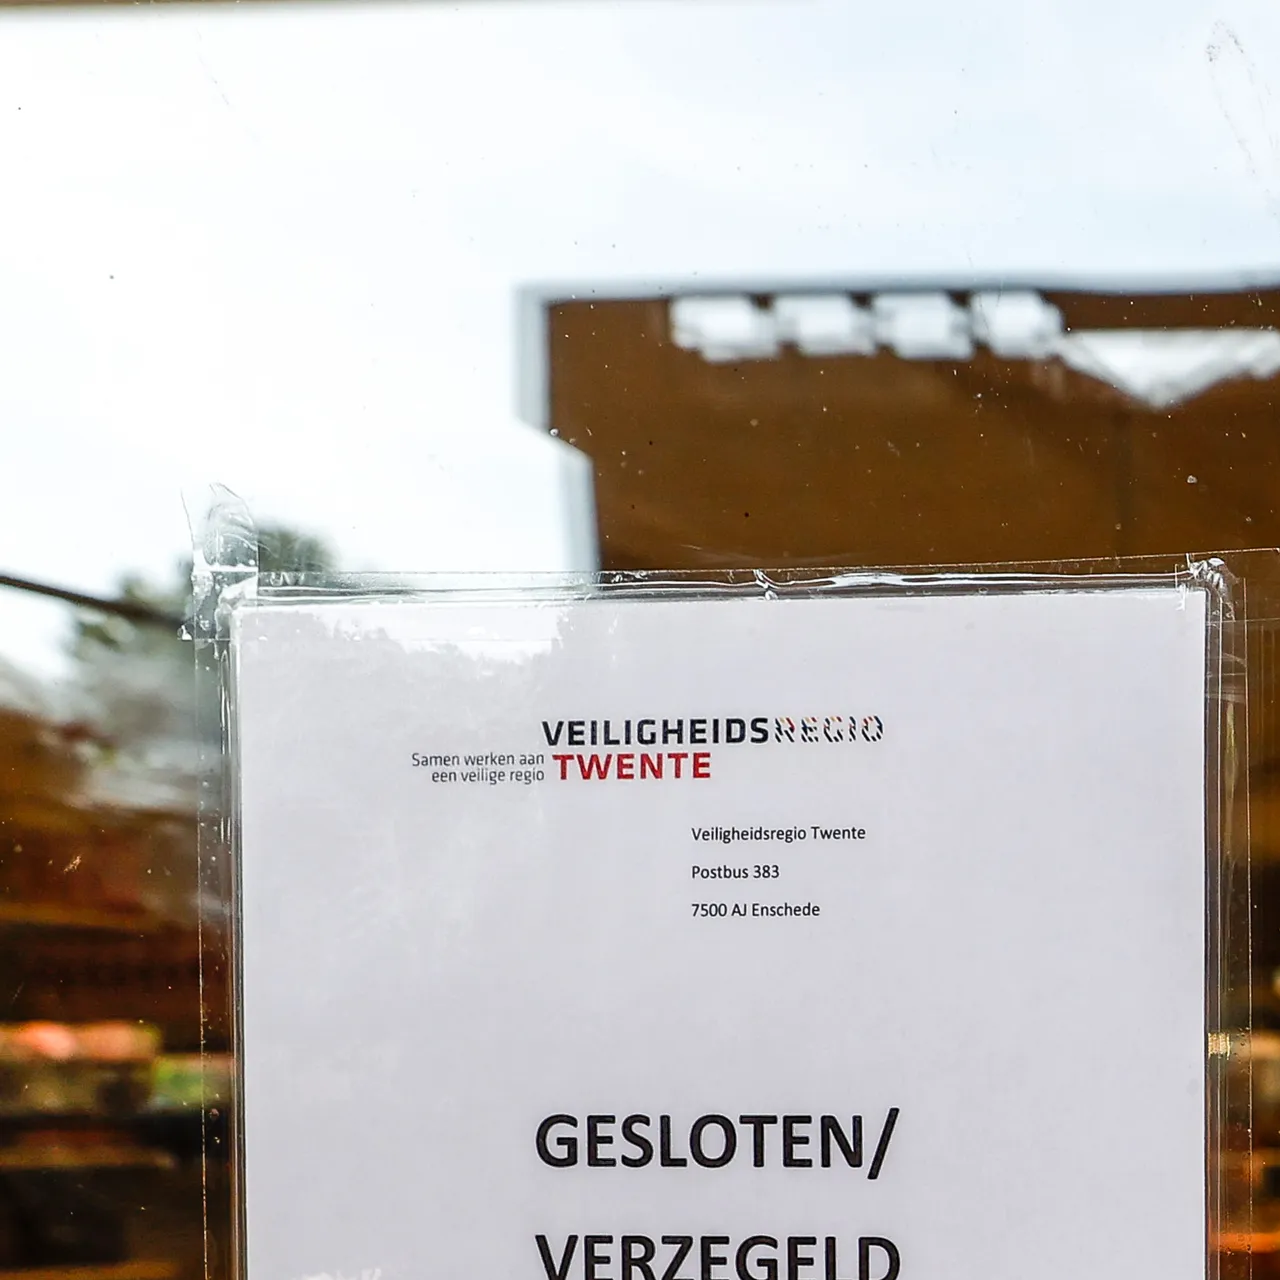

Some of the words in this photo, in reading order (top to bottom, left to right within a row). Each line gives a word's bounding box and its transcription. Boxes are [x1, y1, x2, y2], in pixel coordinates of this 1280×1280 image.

[412, 753, 460, 767] Samen
[464, 752, 515, 766] werken
[519, 754, 544, 766] aan
[552, 752, 711, 780] TWENTE
[432, 771, 457, 783] een
[460, 769, 506, 785] veilige
[510, 769, 544, 785] regio
[691, 826, 807, 844] Veiligheidsregio
[810, 826, 866, 840] Twente
[692, 865, 749, 879] Postbus
[753, 865, 780, 879] 383
[692, 903, 728, 917] 7500
[731, 903, 747, 917] AJ
[752, 902, 820, 917] Enschede
[536, 1107, 900, 1180] GESLOTEN/
